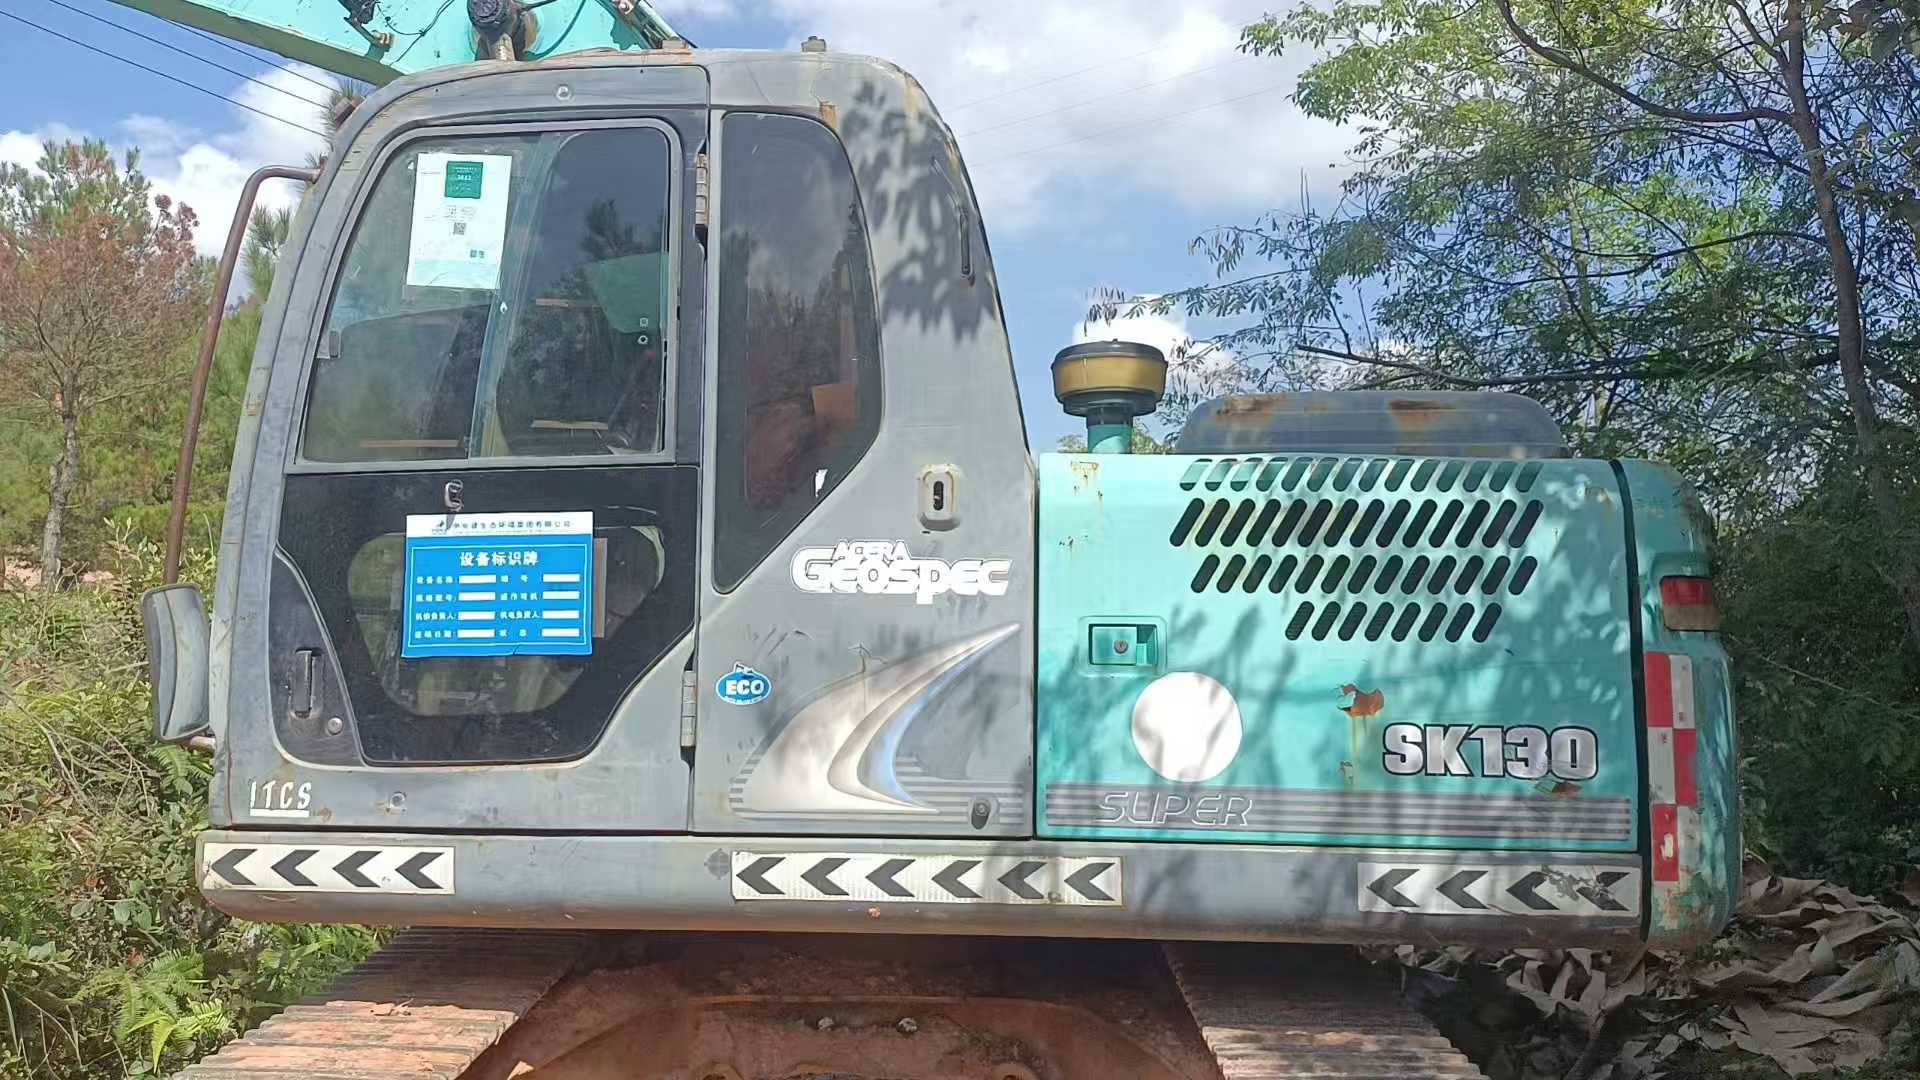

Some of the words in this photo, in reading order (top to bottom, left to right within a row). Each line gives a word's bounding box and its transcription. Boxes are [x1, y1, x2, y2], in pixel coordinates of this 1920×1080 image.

[459, 551, 539, 567] 设备标识牌
[725, 679, 765, 696] ECO
[1382, 722, 1599, 781] SK130
[1096, 791, 1252, 827] SUPER
